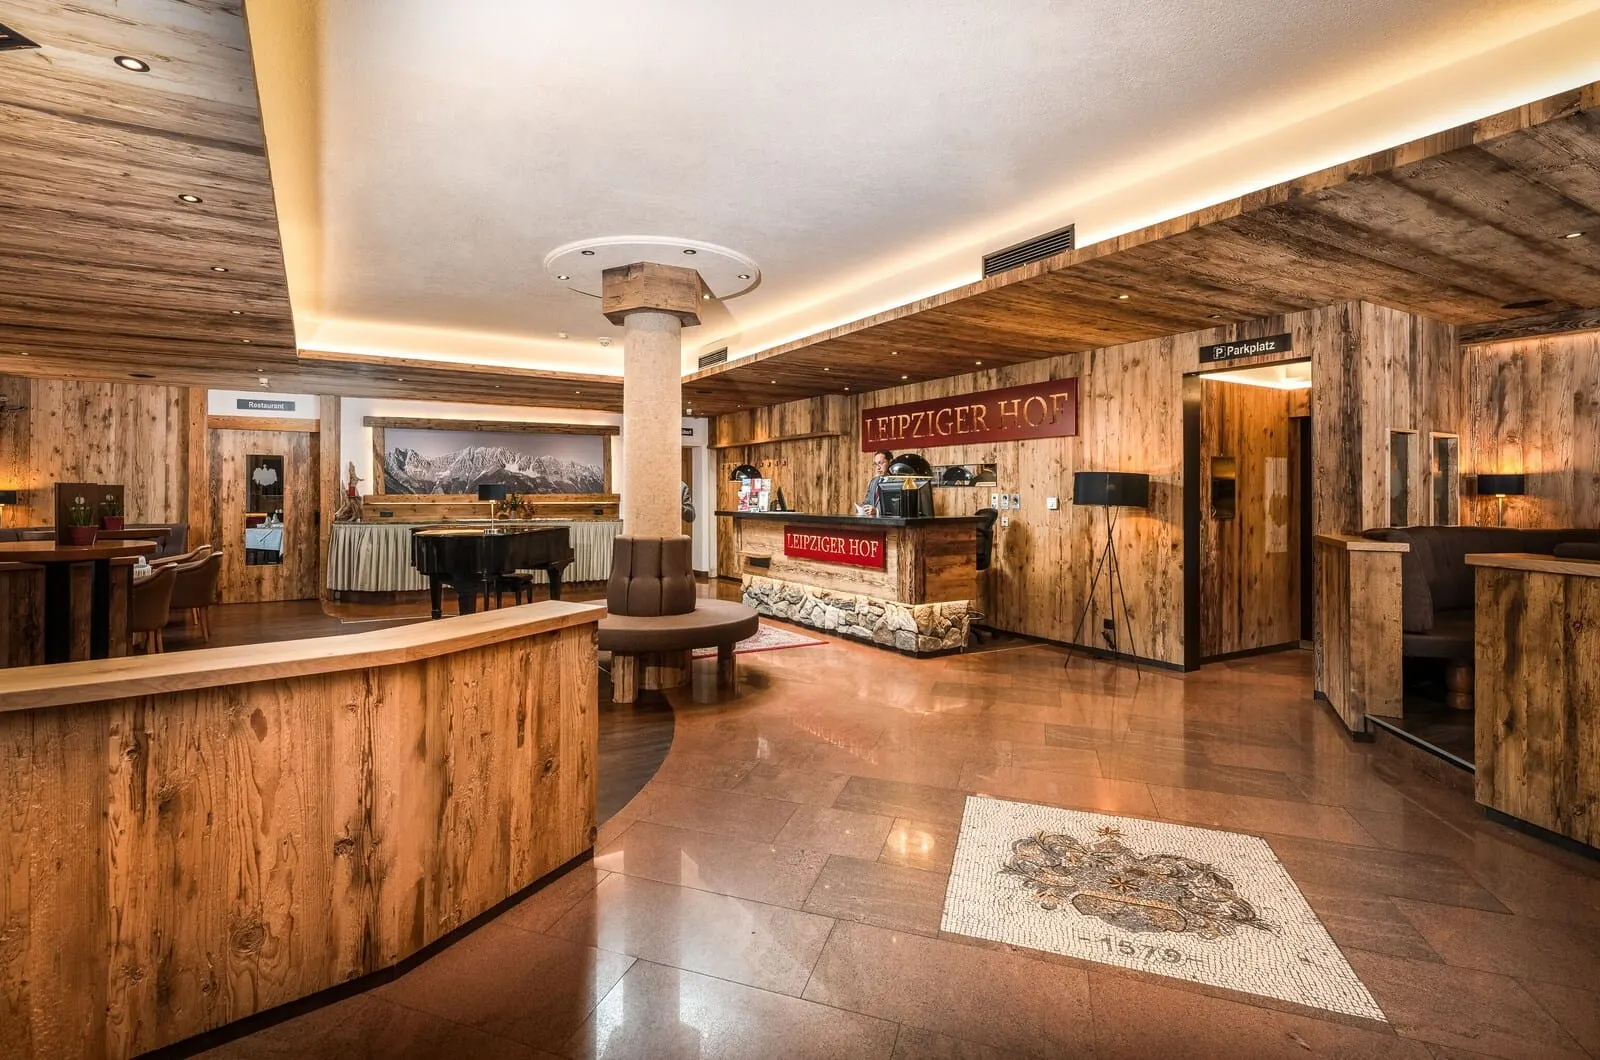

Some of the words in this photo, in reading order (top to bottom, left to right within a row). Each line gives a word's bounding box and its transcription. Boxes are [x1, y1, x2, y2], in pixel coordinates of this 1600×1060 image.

[1227, 341, 1276, 357] Parkplatz
[248, 401, 285, 409] Restaurant
[865, 403, 990, 443] LEIPZIGER
[998, 392, 1068, 430] HOF
[787, 533, 846, 555] LEIPZIGER
[849, 538, 879, 558] HOF
